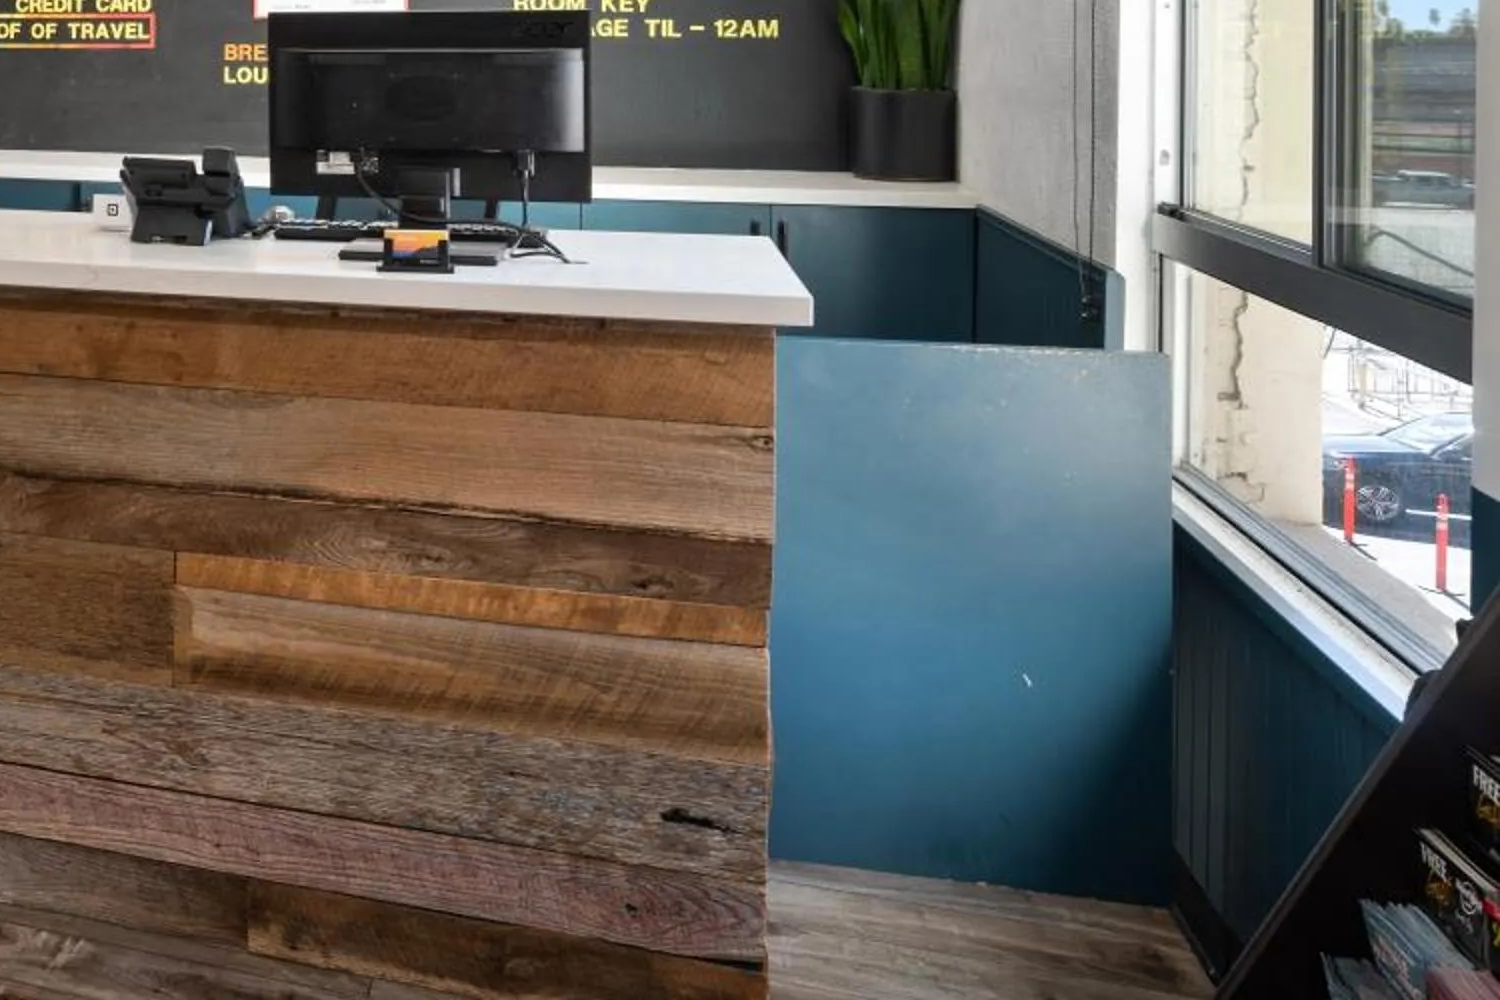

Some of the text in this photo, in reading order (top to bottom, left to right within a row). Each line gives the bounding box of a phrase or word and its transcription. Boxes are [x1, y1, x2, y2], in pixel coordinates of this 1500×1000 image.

[31, 22, 59, 39] OF
[68, 22, 150, 39] TRAVEL
[590, 19, 629, 38] GE
[643, 18, 682, 37] TIL
[714, 19, 779, 39] 12AM
[224, 44, 269, 62] BRE
[223, 66, 269, 85] LOU
